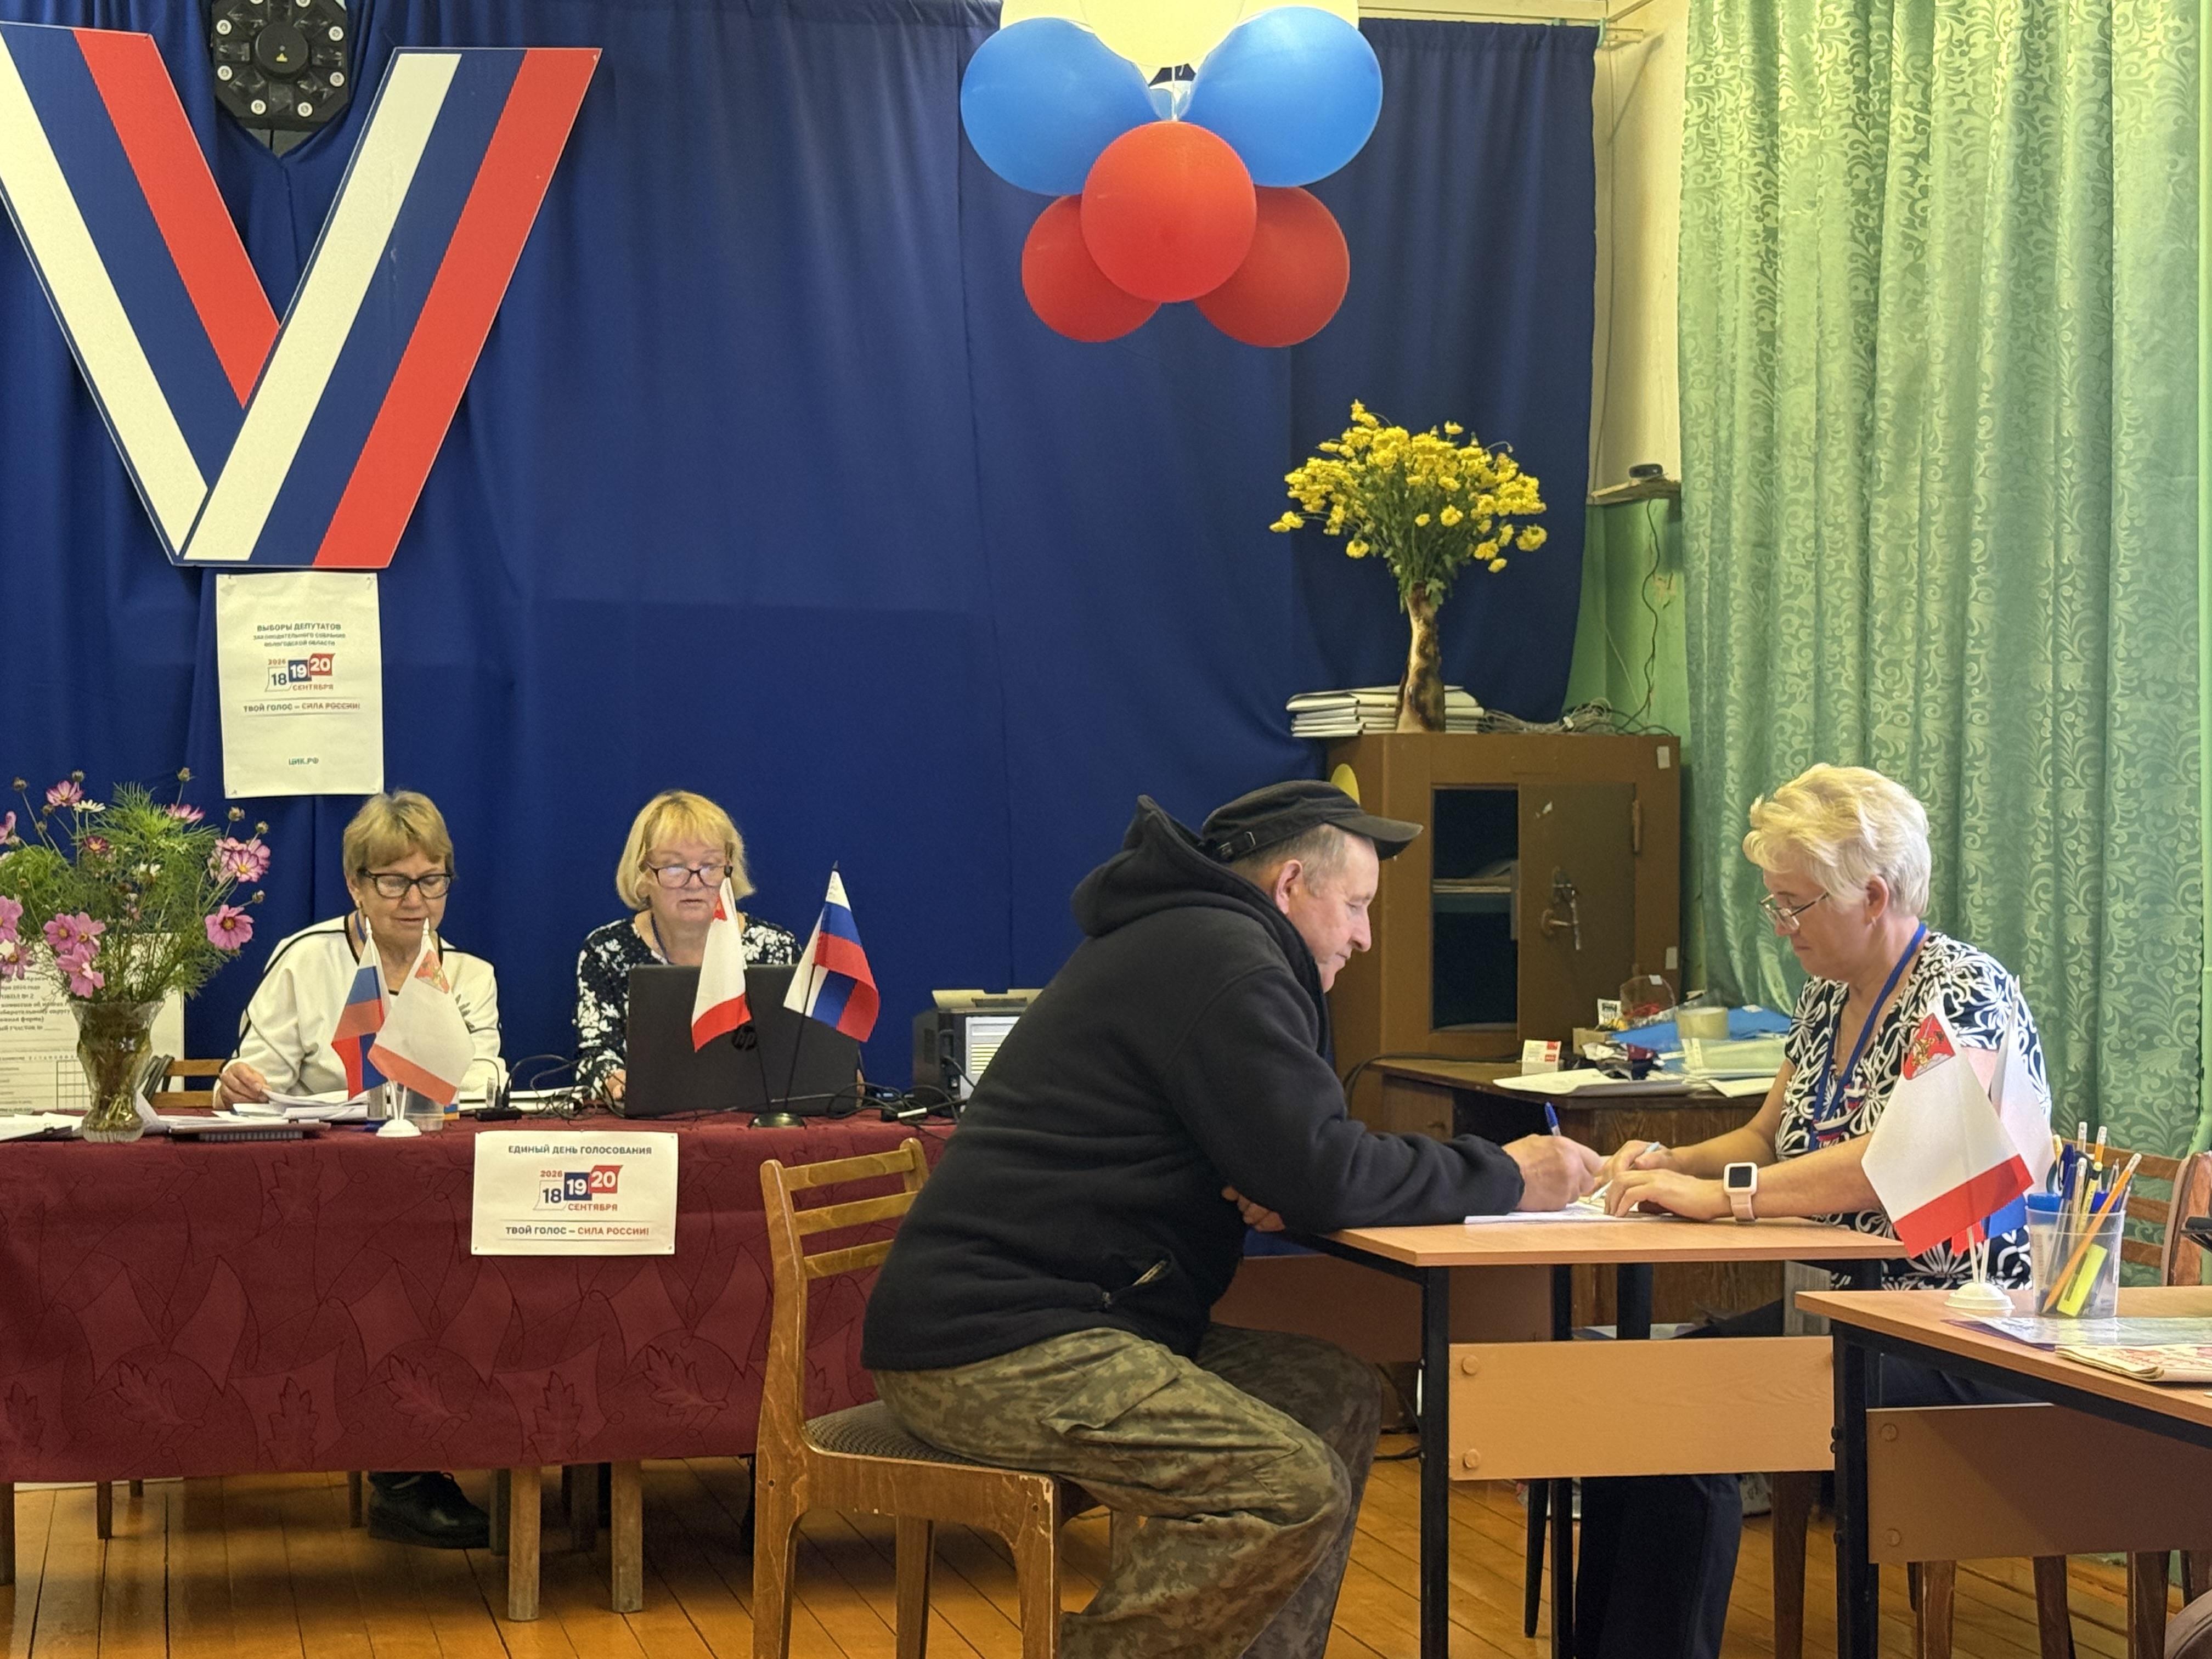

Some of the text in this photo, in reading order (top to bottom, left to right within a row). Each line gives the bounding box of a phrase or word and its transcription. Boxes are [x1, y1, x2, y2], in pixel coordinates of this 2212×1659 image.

[257, 623, 341, 632] ВЫБОРЫ ДЕПУТАТОВ
[271, 657, 331, 686] 18 19 20
[244, 703, 265, 712] ТВОЙ
[289, 757, 319, 765] ЦИК.РФ
[508, 1144, 652, 1155] ЕДИНЫЙ ДЕНЬ ГОЛОСОВАНИЯ
[542, 1171, 616, 1204] 18 19 20
[568, 1203, 618, 1211] СЕНТЯБРЯ
[506, 1225, 532, 1235] ТВОЙ
[534, 1227, 567, 1235] ГОЛОС
[578, 1227, 605, 1235] СИЛА
[606, 1227, 650, 1235] РОССИИ!
